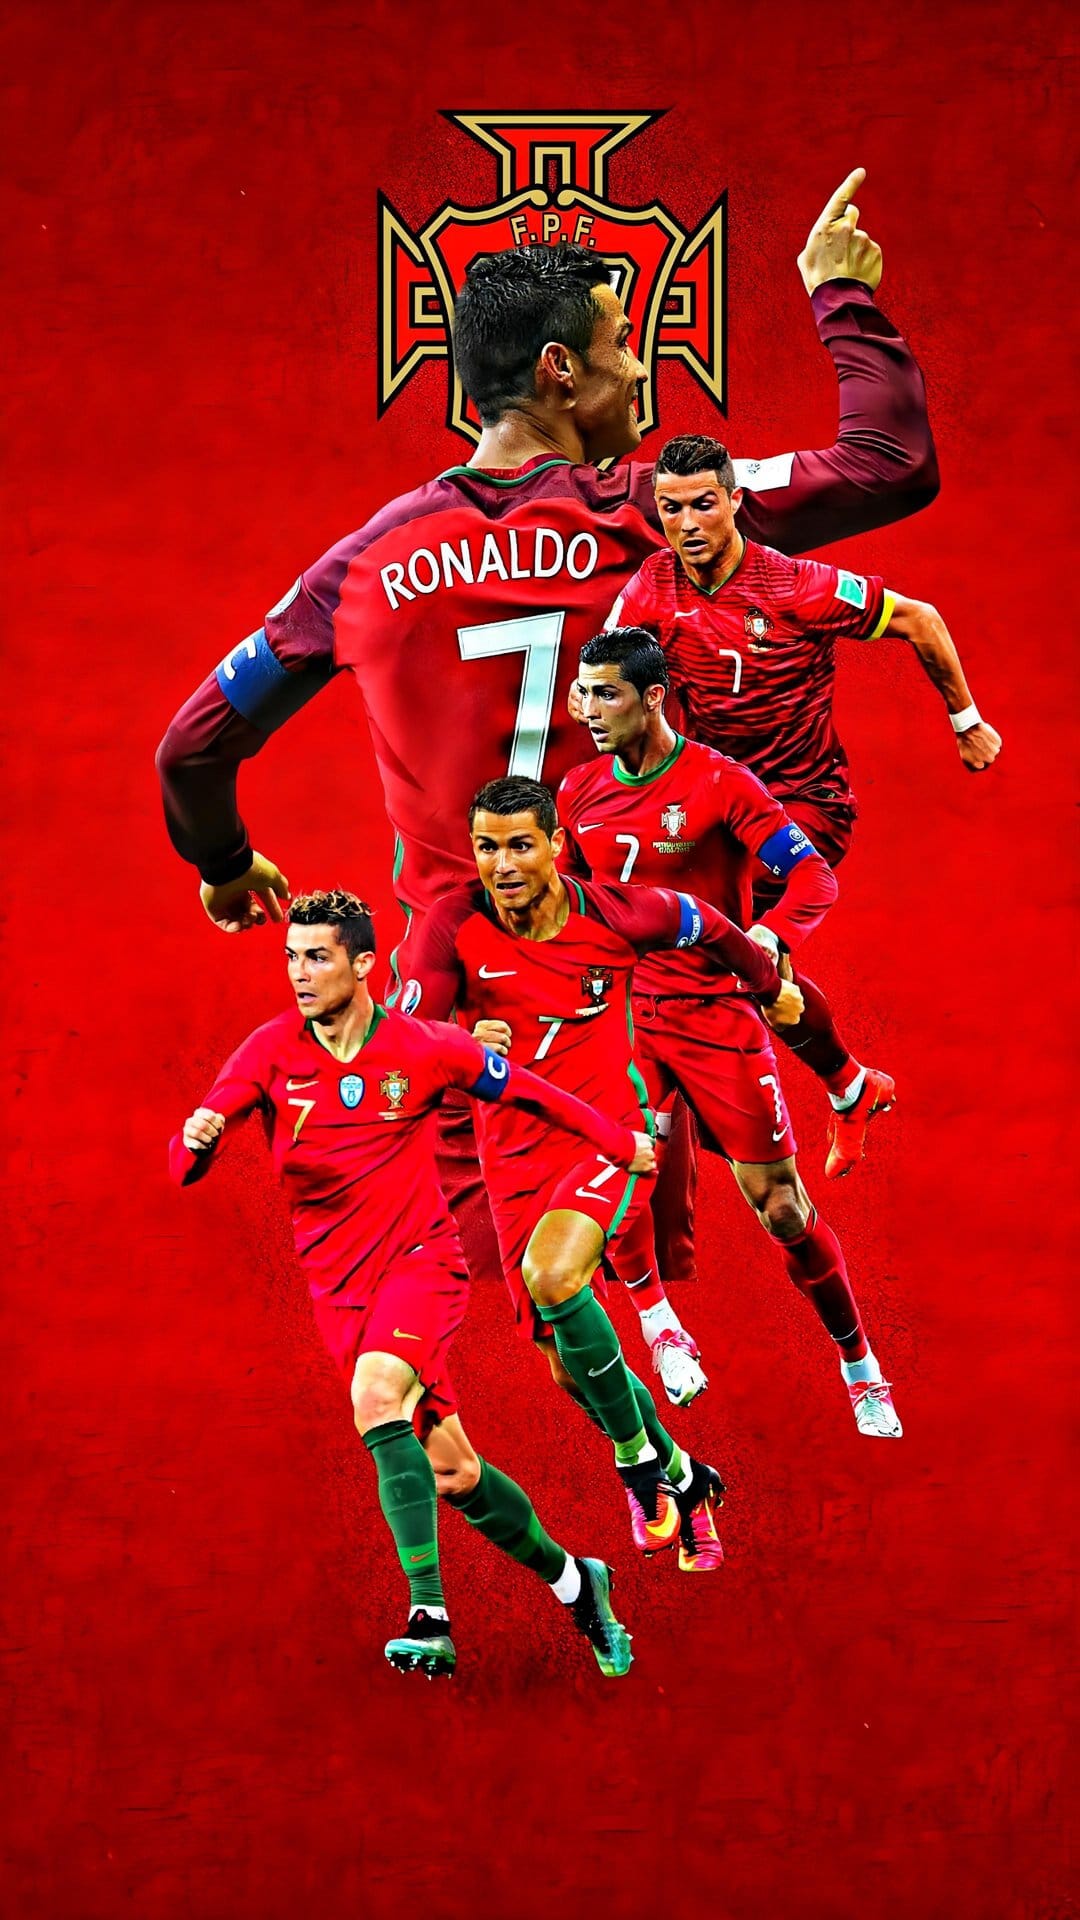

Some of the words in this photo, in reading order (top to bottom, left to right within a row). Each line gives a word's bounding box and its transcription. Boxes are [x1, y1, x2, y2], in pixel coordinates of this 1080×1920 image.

[510, 213, 596, 245] F.P.F.
[379, 526, 599, 611] RONALDO
[223, 636, 257, 681] C
[718, 648, 742, 693] 7
[456, 610, 566, 784] 7
[615, 833, 640, 883] 7
[533, 1015, 565, 1060] 7
[487, 1055, 506, 1080] C
[287, 1097, 317, 1142] 7
[759, 1074, 782, 1124] 7
[587, 1153, 620, 1189] 7
